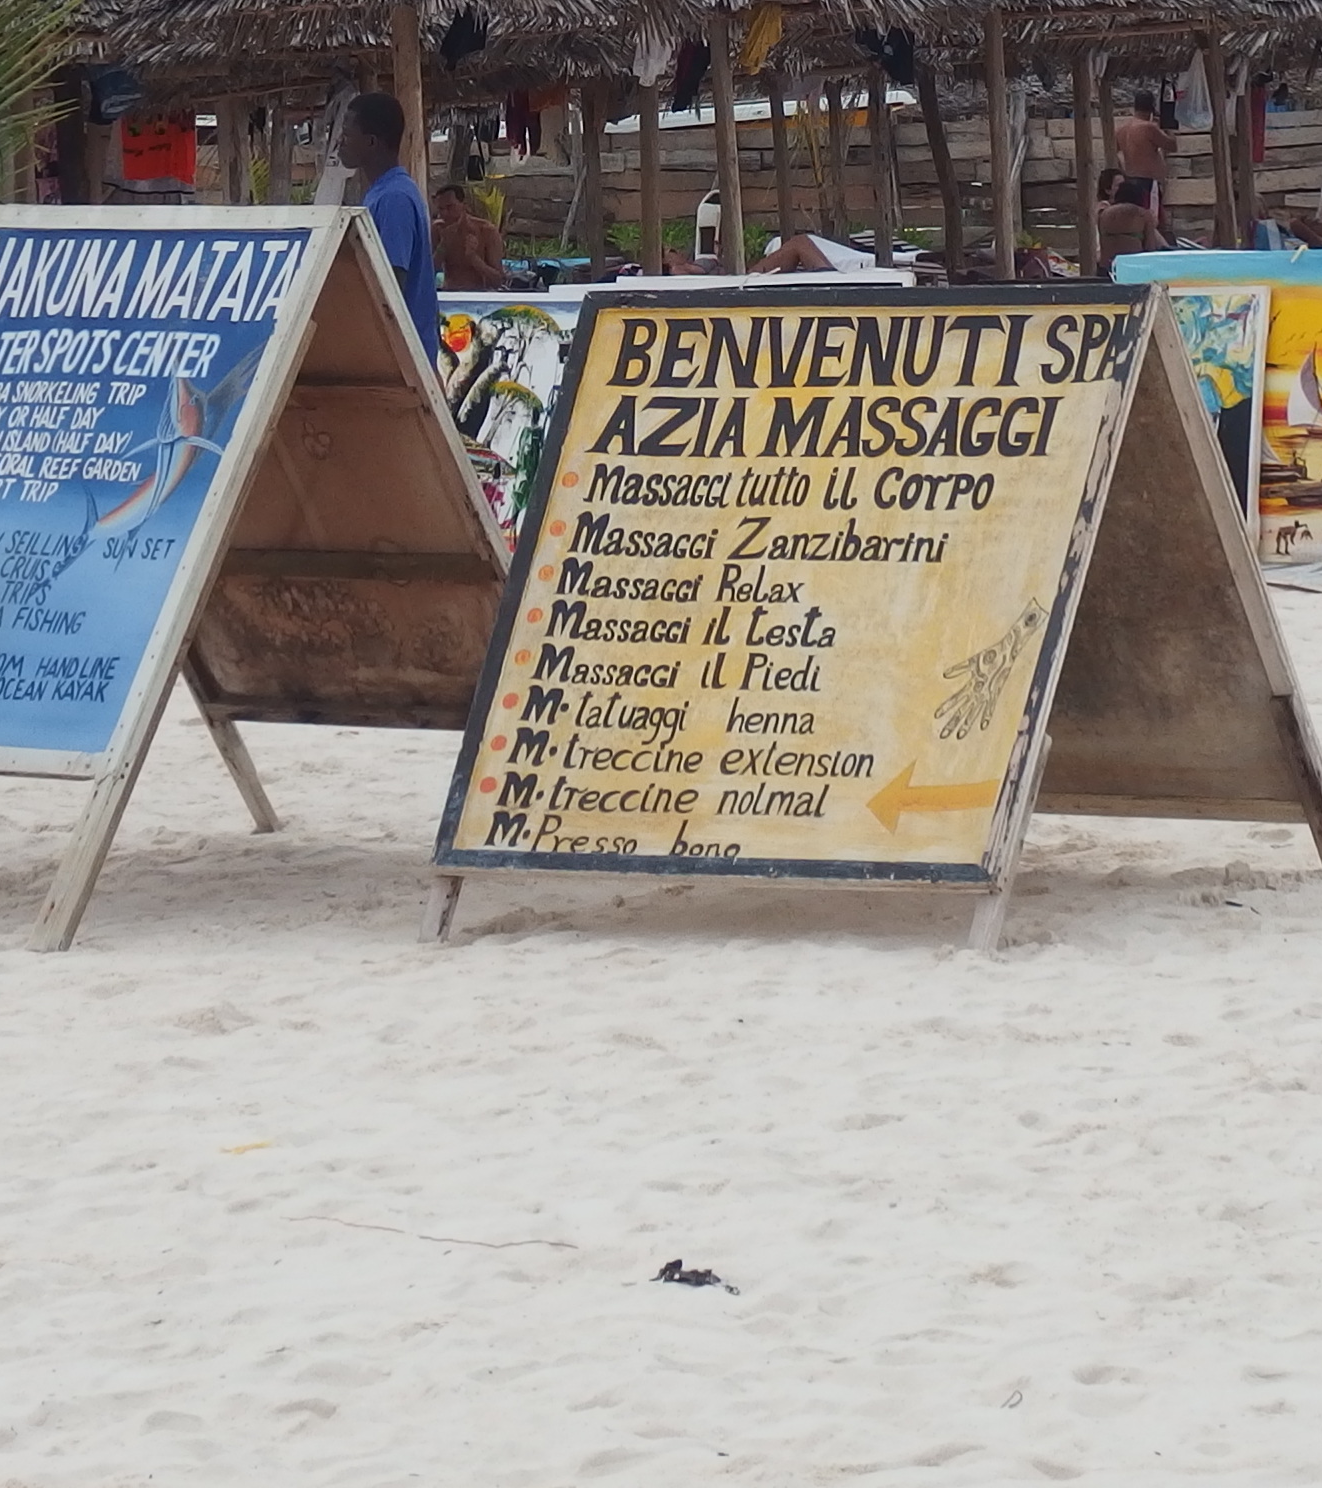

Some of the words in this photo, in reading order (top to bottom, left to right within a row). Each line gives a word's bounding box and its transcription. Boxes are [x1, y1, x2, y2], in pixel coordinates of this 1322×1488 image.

[124, 239, 302, 322] MATATA
[112, 330, 221, 378] CENTER
[606, 315, 1033, 389] BENVENUTI
[11, 380, 100, 404] SNORKELING
[106, 382, 147, 406] TRIP
[8, 406, 30, 428] OR
[29, 406, 71, 429] HALF
[70, 407, 105, 430] DAY
[584, 395, 746, 458] AZIA
[757, 396, 1064, 458] MASSAGGI
[2, 430, 51, 453] ISLAND
[51, 430, 93, 454] (HALF
[93, 431, 133, 455] DAY)
[38, 458, 81, 479] REEF
[82, 457, 142, 482] GARDEN
[735, 466, 811, 508] tutto
[823, 466, 858, 510] il
[20, 480, 59, 503] TRIP
[727, 516, 949, 563] Zanzibarini
[0, 581, 52, 606] TRIPS
[715, 563, 805, 603] Relax
[12, 606, 86, 635] FISHING
[701, 606, 731, 646] il
[746, 605, 836, 648] testa
[51, 679, 110, 703] KAYAK
[701, 652, 727, 689] il
[739, 652, 821, 692] Piedi
[726, 697, 815, 735] henna
[719, 740, 875, 778] extension
[715, 783, 830, 818] nolmal
